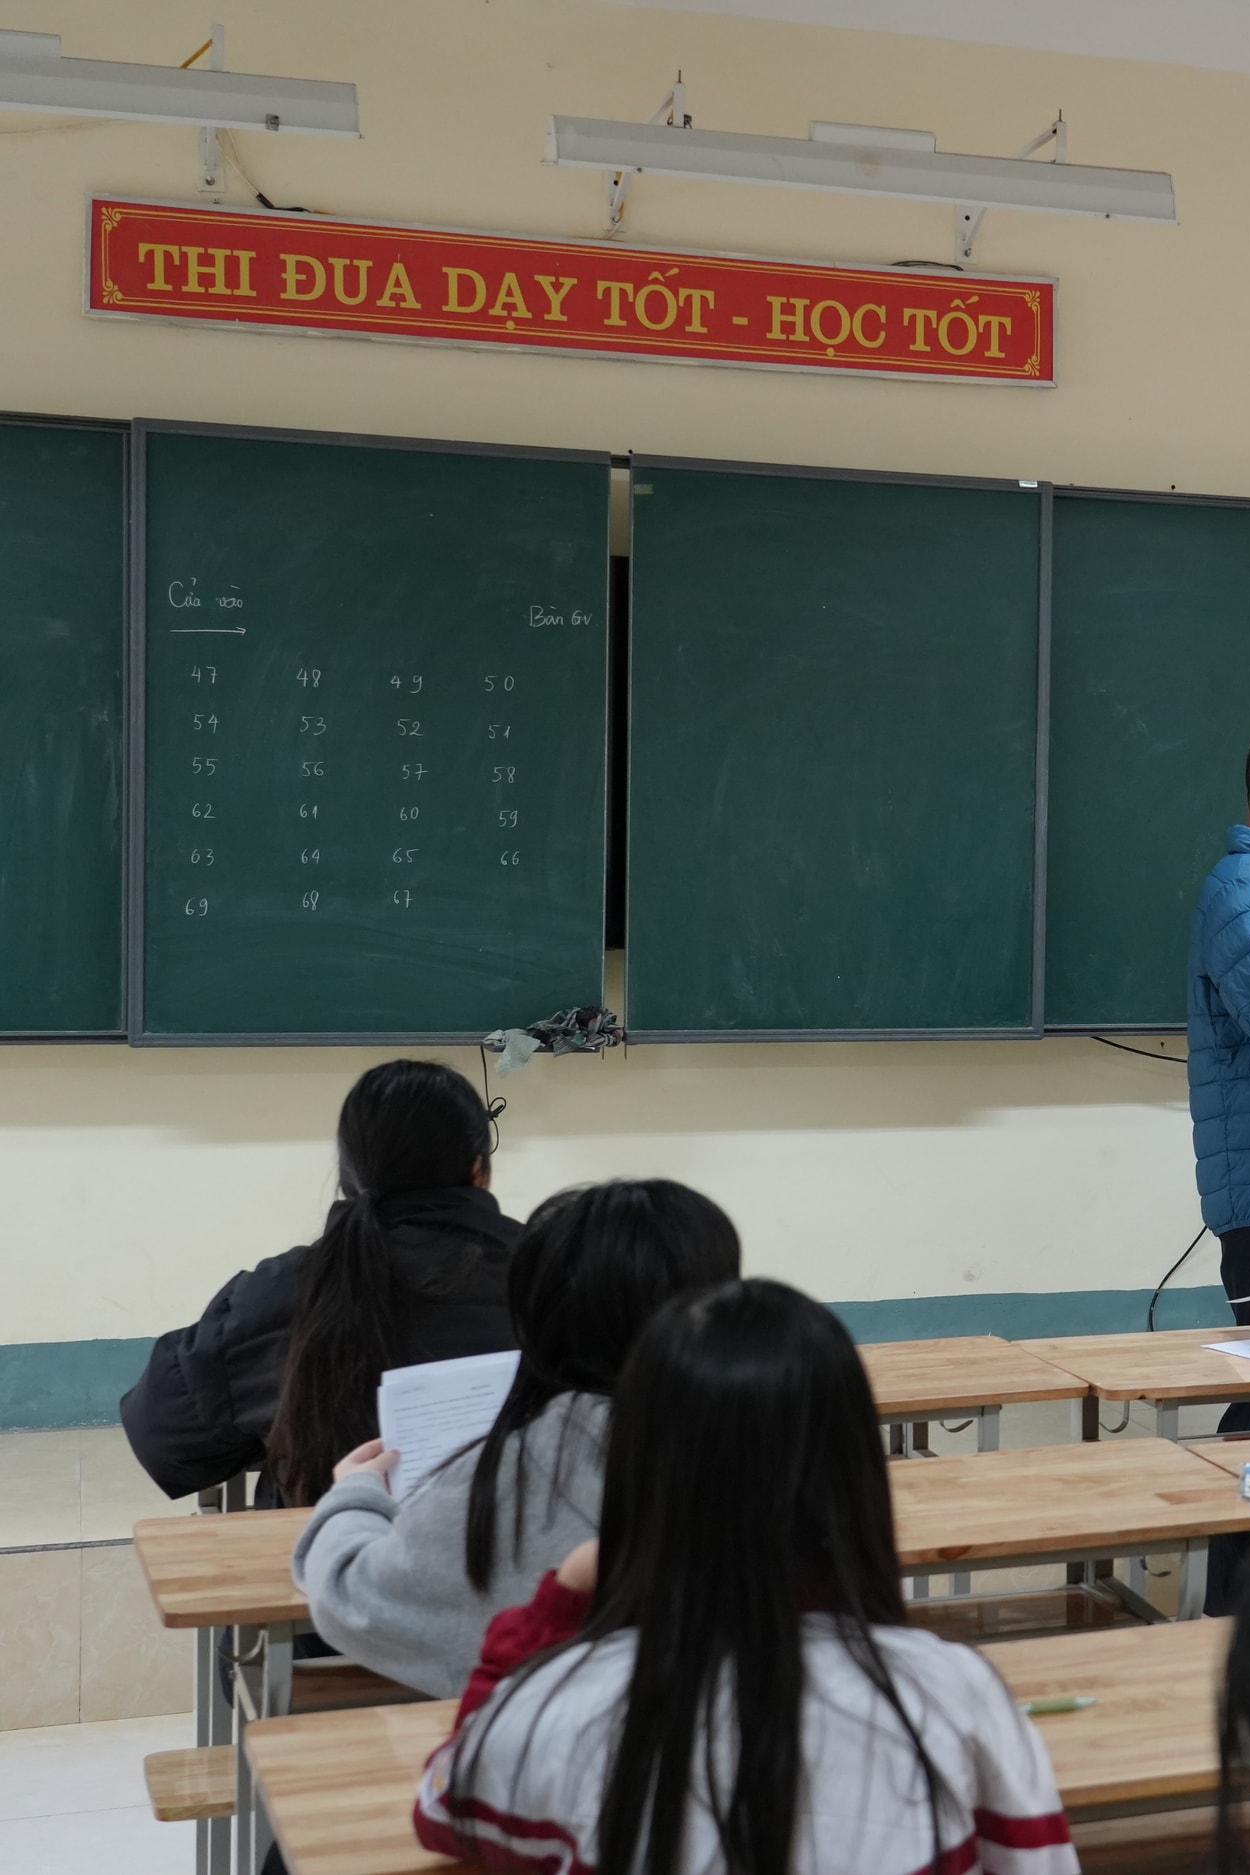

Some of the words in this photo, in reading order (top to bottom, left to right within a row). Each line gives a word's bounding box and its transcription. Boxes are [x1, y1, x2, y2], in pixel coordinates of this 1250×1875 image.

[138, 242, 257, 297] THI
[279, 252, 422, 310] ĐUA
[442, 266, 578, 331] DẠY
[597, 267, 715, 334] TỐT
[732, 315, 749, 326] -
[766, 296, 887, 358] HỌC
[903, 295, 1012, 359] TỐT
[215, 584, 244, 608] vào
[529, 605, 564, 628] Bàn
[192, 666, 216, 684] 47
[297, 667, 321, 687] 48
[390, 675, 422, 694] 49
[484, 675, 514, 692] 50
[194, 713, 219, 733] 54
[300, 716, 326, 736] 53
[398, 718, 423, 737] 52
[488, 724, 510, 740] 51
[192, 757, 217, 776] 55
[302, 761, 324, 777] 56
[402, 763, 428, 780] 57
[492, 766, 515, 784] 58
[192, 803, 216, 819] 62
[300, 803, 318, 820] 61
[399, 806, 419, 821] 60
[499, 810, 518, 828] 59
[191, 848, 214, 866] 63
[301, 848, 320, 864] 64
[392, 848, 419, 864] 65
[500, 850, 519, 866] 66
[185, 898, 208, 916] 69
[302, 889, 319, 911] 68
[393, 889, 413, 908] 67
